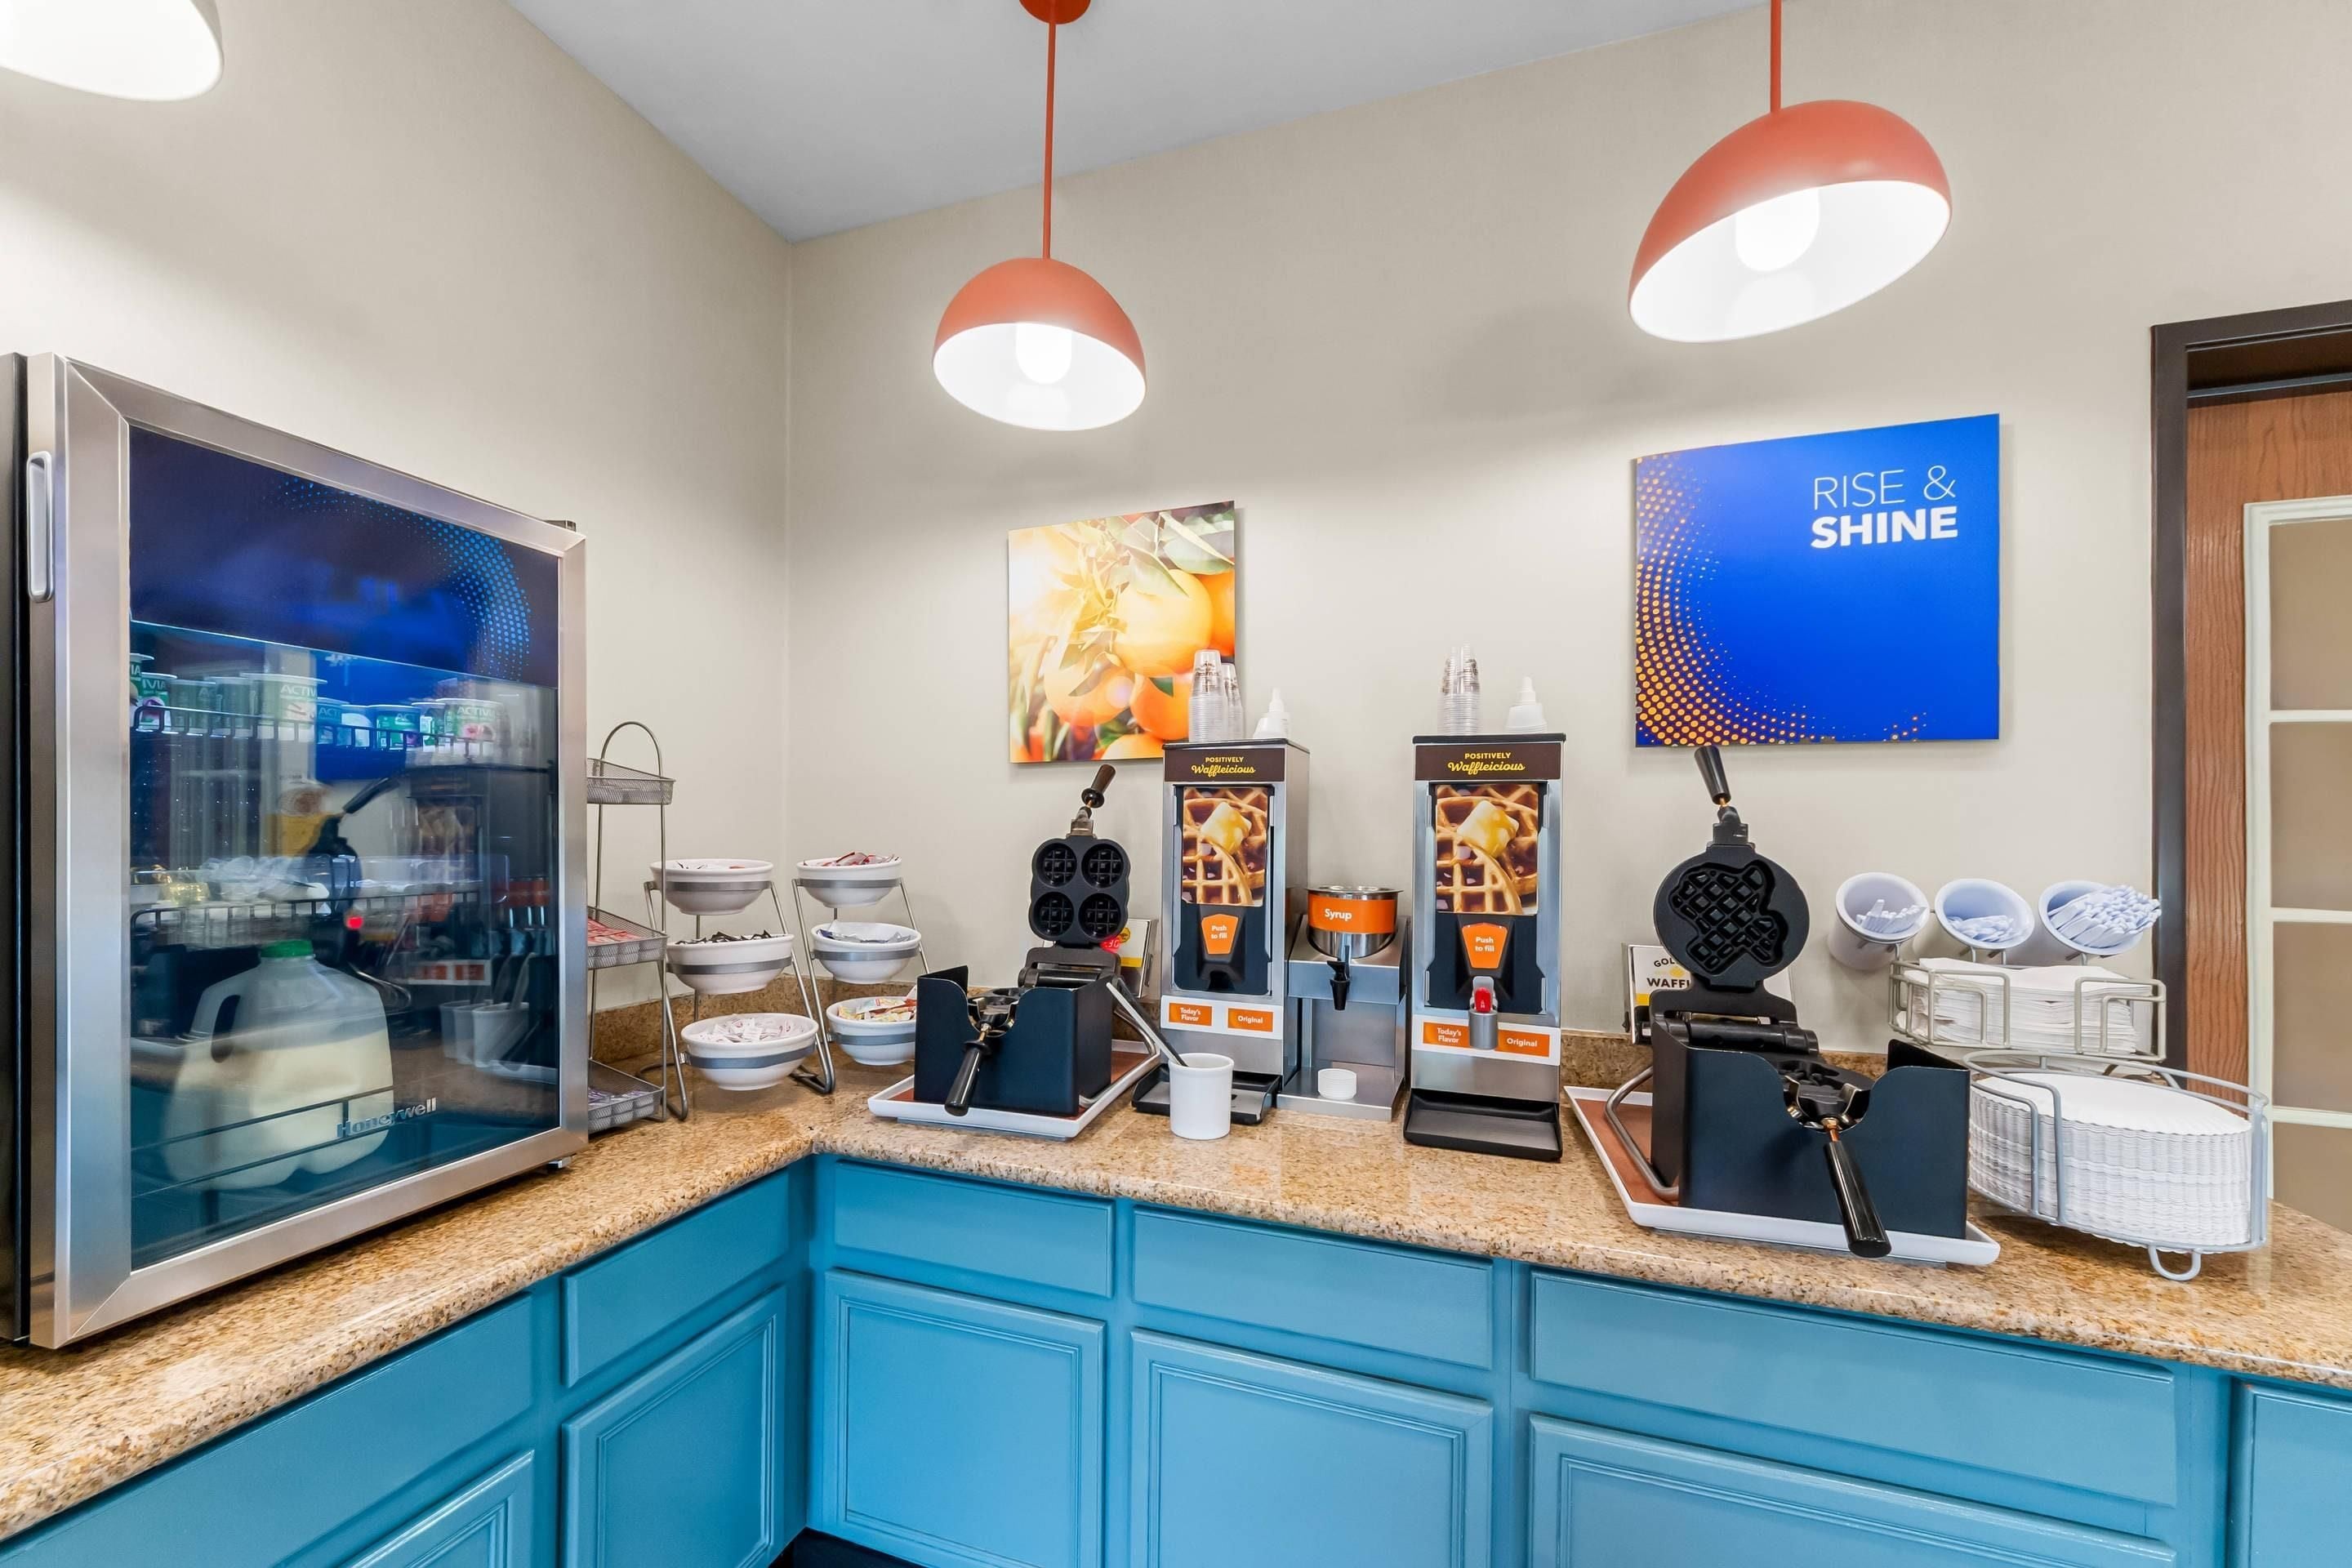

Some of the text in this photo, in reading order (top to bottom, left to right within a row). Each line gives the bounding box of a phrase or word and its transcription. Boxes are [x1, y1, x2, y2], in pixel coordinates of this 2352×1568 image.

[1814, 465, 1956, 510] RISE &
[1811, 506, 1958, 549] SHINE
[1191, 764, 1256, 777] Waffleicious
[1447, 760, 1526, 775] Waffleicious
[1325, 908, 1352, 922] Syrup
[1211, 924, 1227, 933] Push
[1180, 1007, 1201, 1016] Today's
[1237, 1015, 1263, 1024] Original
[1437, 1027, 1462, 1036] Today's
[1437, 1035, 1459, 1044] Flavor
[1506, 1037, 1538, 1048] Original
[336, 1097, 437, 1138] Honeywell
